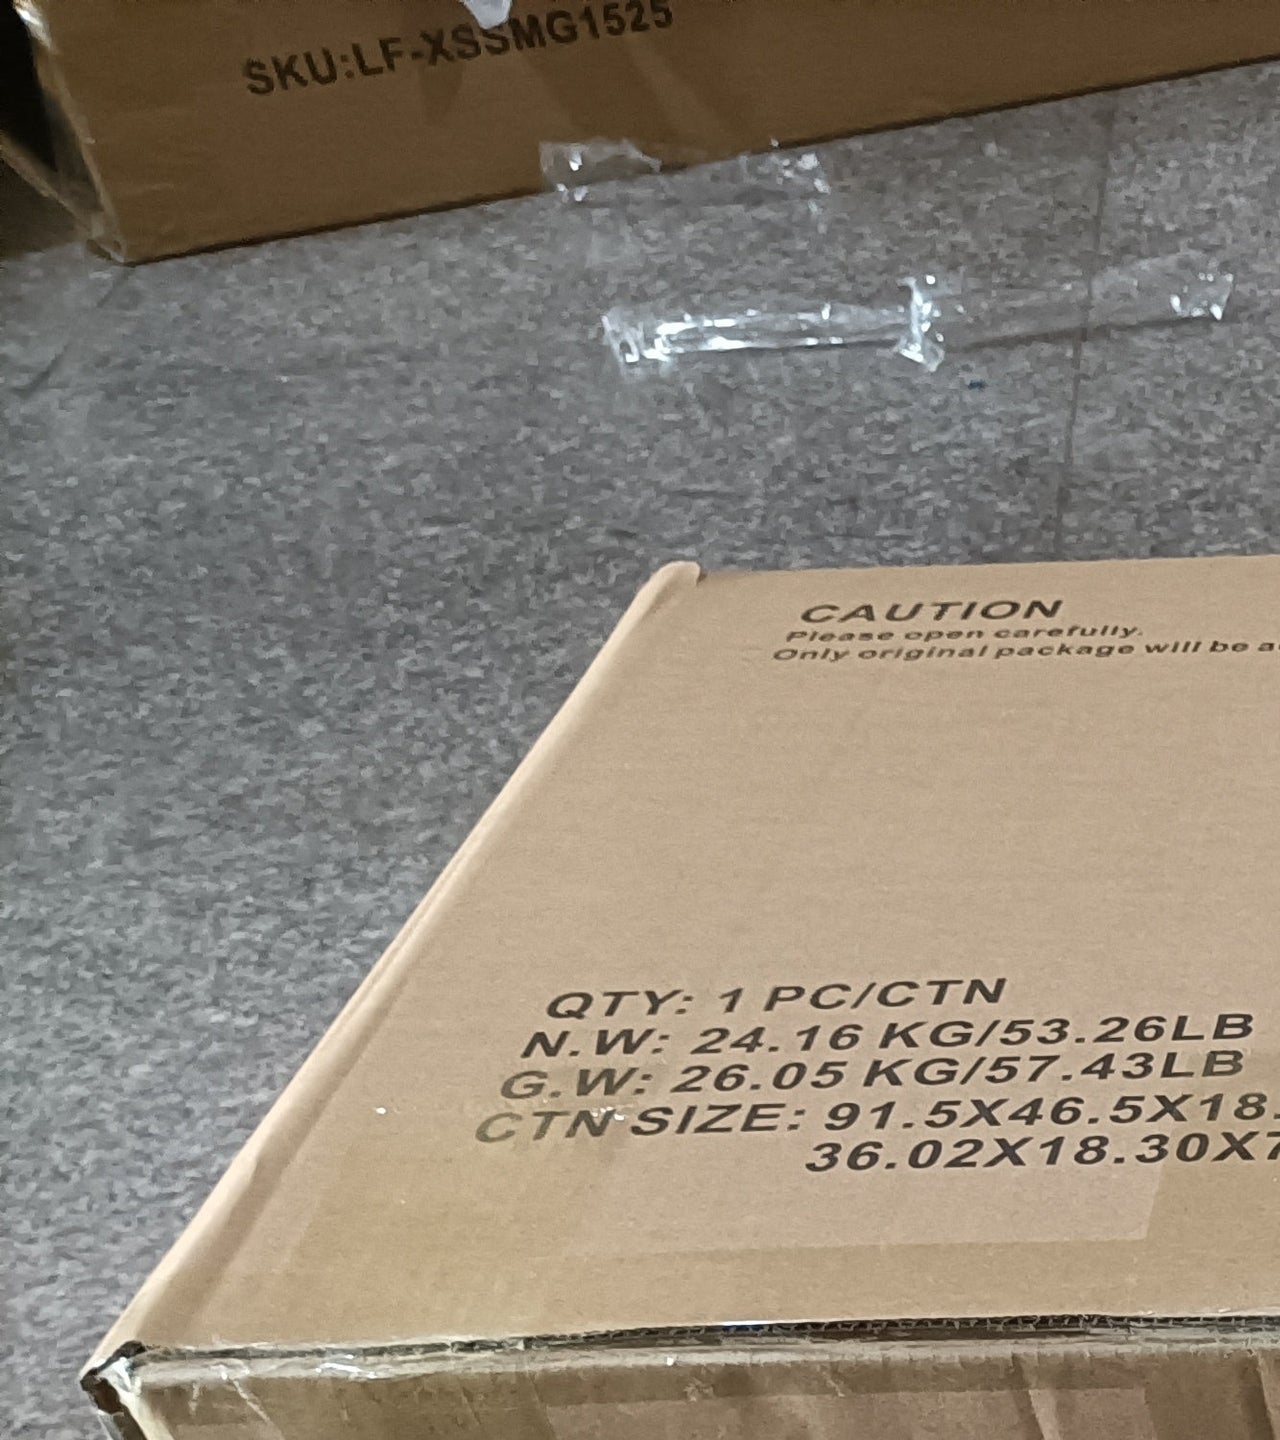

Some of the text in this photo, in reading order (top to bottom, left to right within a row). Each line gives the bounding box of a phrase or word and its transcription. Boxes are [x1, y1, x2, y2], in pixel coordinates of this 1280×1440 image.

[799, 599, 1063, 624] CAUTION
[772, 647, 850, 663] Only
[857, 644, 989, 662] original
[994, 642, 1135, 660] package
[1144, 640, 1204, 654] will
[1209, 639, 1250, 653] be
[785, 624, 1143, 643] Please open carefully.
[546, 977, 1008, 1020] QTY: 1 PC/CTN
[520, 1012, 1255, 1059] N.W: 24.16 KG/53.26LB
[500, 1049, 1246, 1100] G.W: 26.05 KG/57.43LB
[474, 1108, 618, 1144] CTN
[630, 1102, 807, 1136] SIZE:
